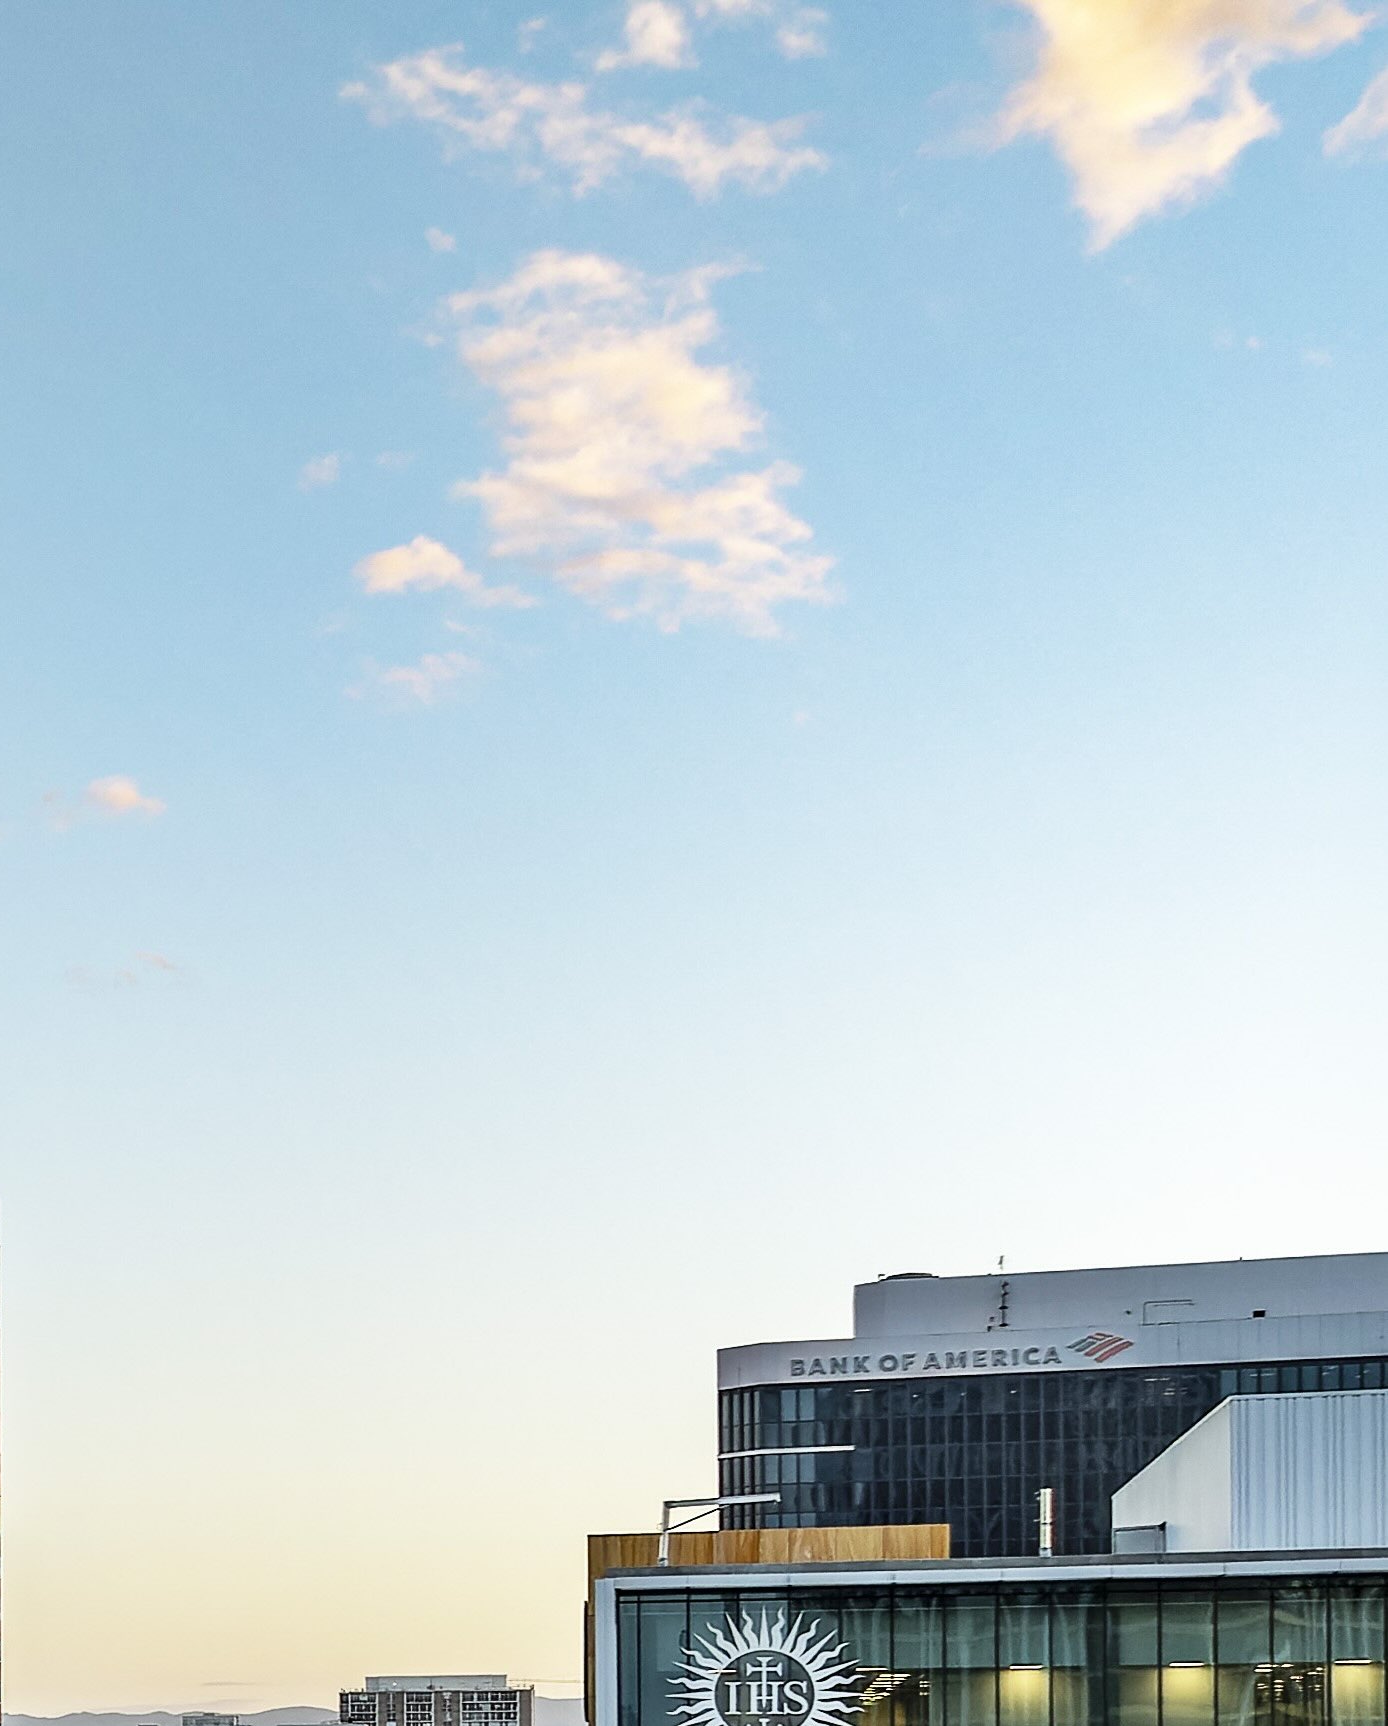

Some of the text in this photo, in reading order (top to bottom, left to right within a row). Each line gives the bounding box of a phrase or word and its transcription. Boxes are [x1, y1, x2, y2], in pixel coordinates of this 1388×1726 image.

[790, 1346, 1062, 1377] BANK OF AMERICA
[725, 1680, 809, 1715] IHS
